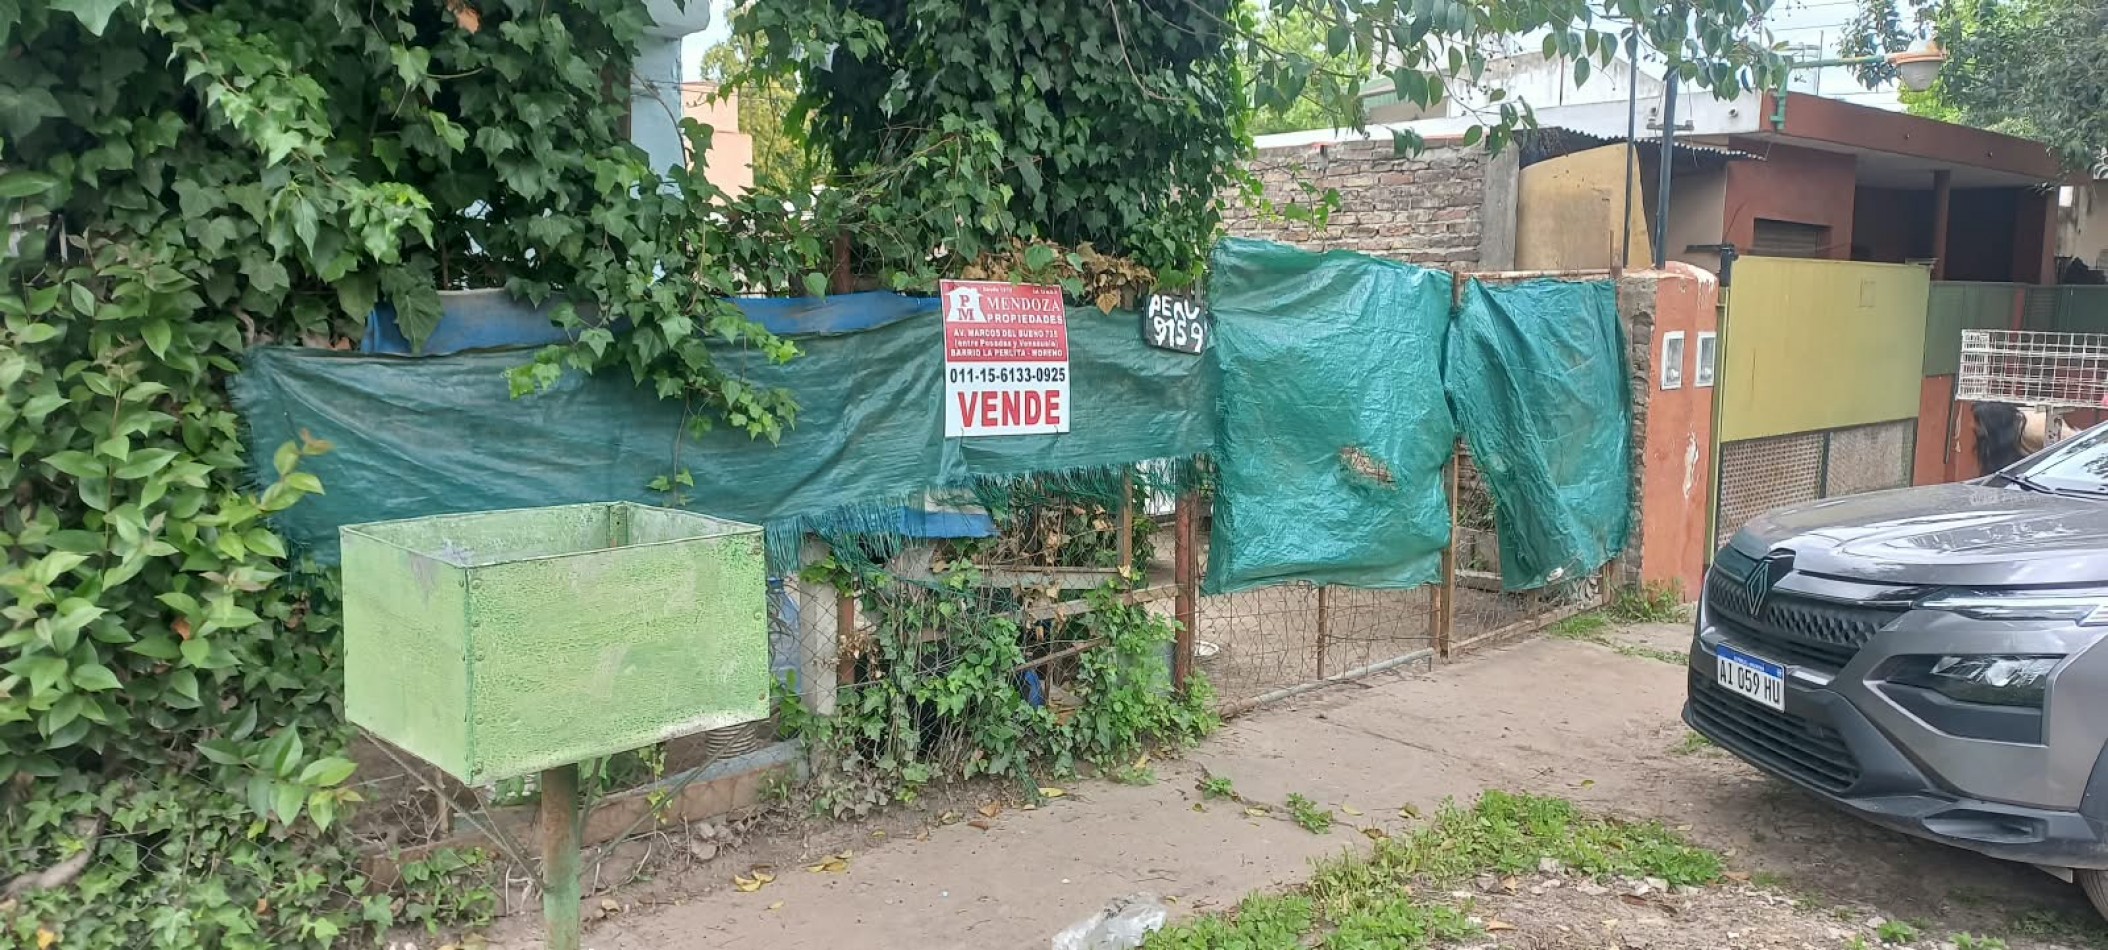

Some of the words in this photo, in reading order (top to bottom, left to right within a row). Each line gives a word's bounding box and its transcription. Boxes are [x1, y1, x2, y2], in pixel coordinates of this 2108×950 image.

[960, 295, 970, 306] P
[988, 297, 1060, 311] MENDOZA
[958, 308, 974, 320] M
[1149, 294, 1200, 321] PERU
[987, 314, 1064, 325] PROPIEDADES
[953, 328, 966, 338] AV.
[967, 328, 1001, 338] MARCOS
[1002, 329, 1017, 338] DEL
[1018, 329, 1044, 338] BUENO
[1153, 315, 1203, 353] 9159
[954, 339, 979, 348] (entre
[980, 339, 1012, 348] Posadas
[1019, 339, 1060, 349] Venezuela)
[950, 348, 981, 358] BARRIO
[982, 348, 993, 357] LA
[994, 348, 1026, 358] PERLITA
[1031, 348, 1063, 358] MORENO
[950, 368, 1065, 383] 011-15-6133-0925
[957, 390, 1060, 428] VENDE
[1720, 659, 1733, 685] AI
[1737, 667, 1760, 695] 059
[1764, 677, 1780, 703] HU
